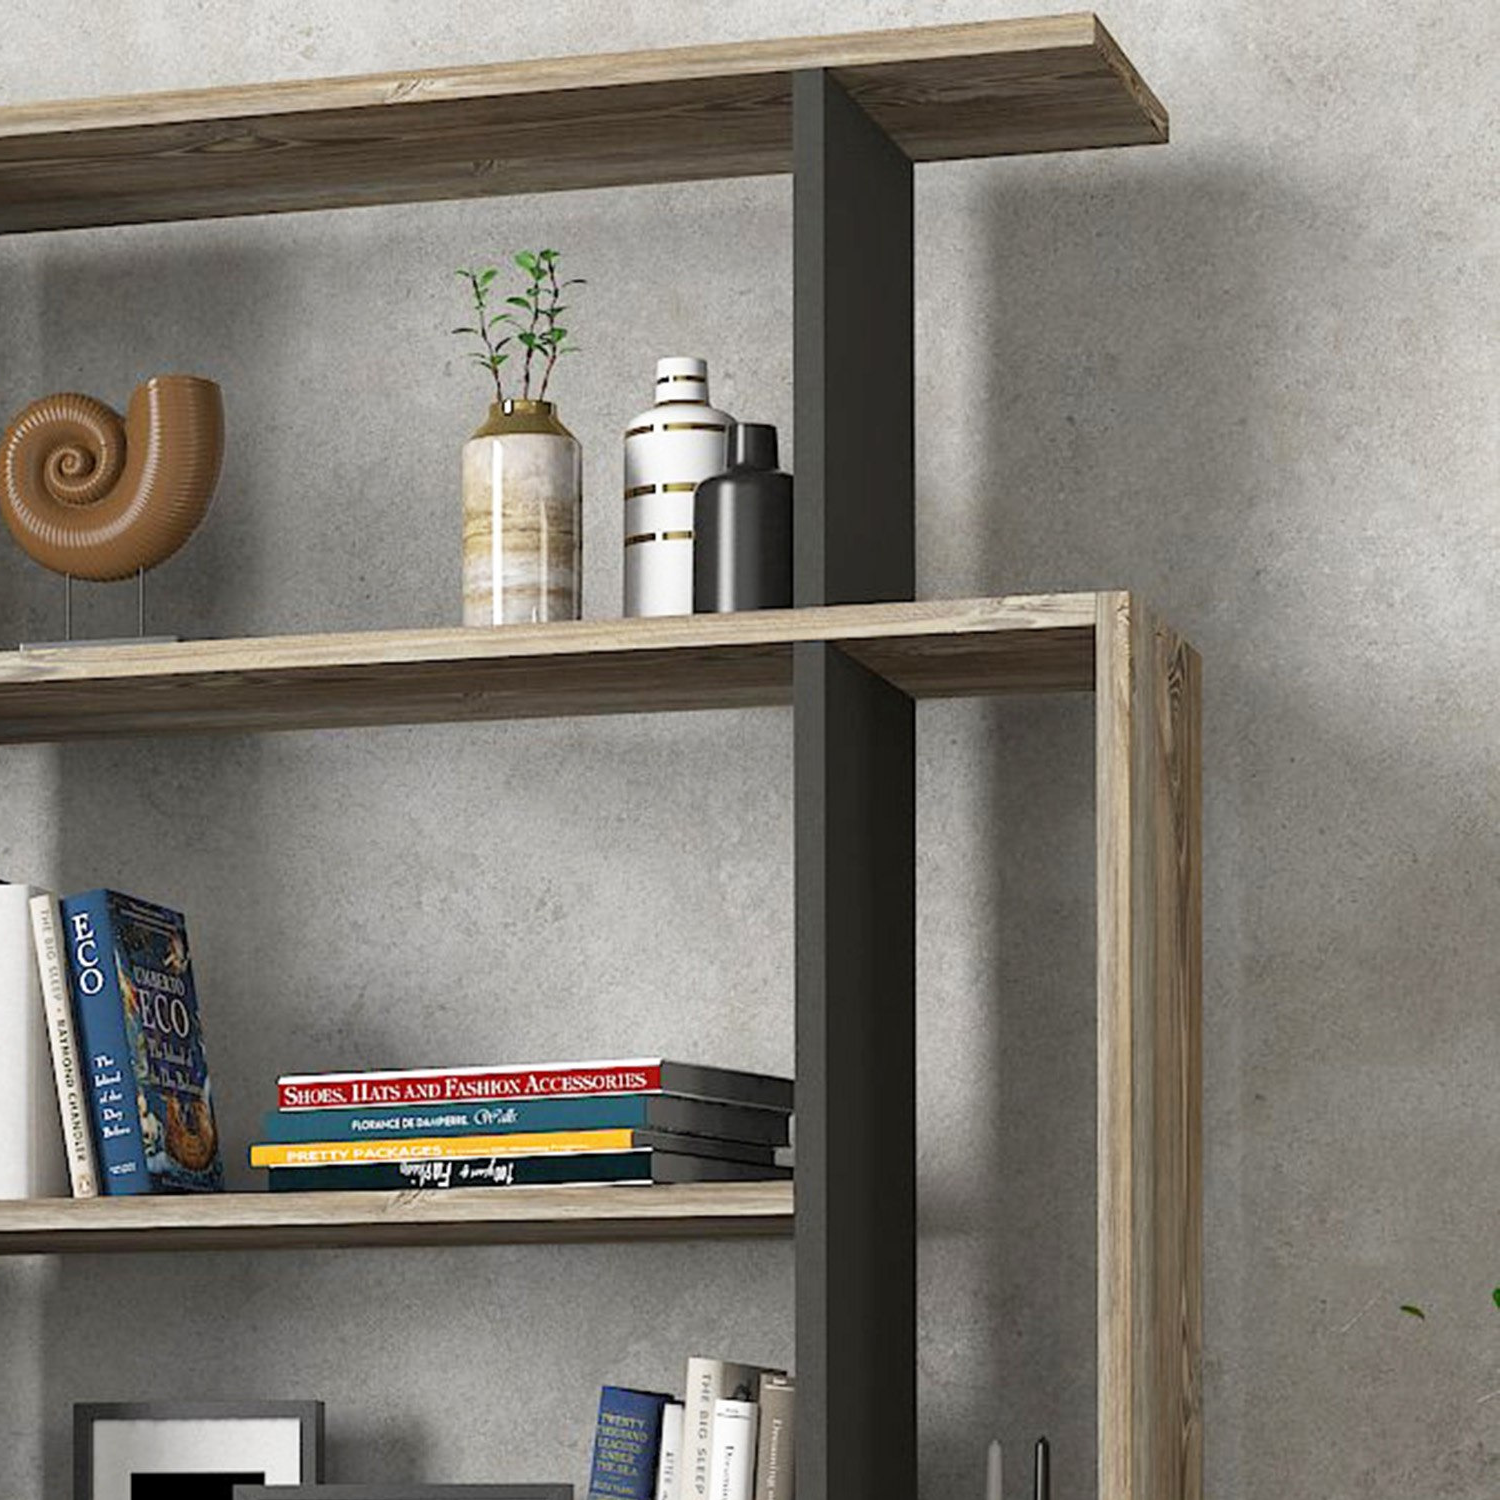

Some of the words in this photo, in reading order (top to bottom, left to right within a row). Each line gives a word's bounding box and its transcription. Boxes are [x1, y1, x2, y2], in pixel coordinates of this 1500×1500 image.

[41, 909, 51, 931] THE
[44, 937, 56, 960] BIG
[71, 912, 104, 995] ECO
[139, 988, 189, 1038] ECO
[56, 1019, 74, 1088] RAYMOND
[403, 1083, 440, 1099] AND
[524, 1072, 648, 1094] ACCESSORIES
[68, 1092, 86, 1162] CHANDLER
[402, 1118, 414, 1130] DE
[286, 1149, 351, 1162] PRETTY
[353, 1145, 442, 1160] PACKAGES
[700, 1374, 712, 1401] THE
[699, 1410, 710, 1440] BIG
[766, 1418, 782, 1488] Dreaming
[695, 1448, 708, 1494] SLEEP
